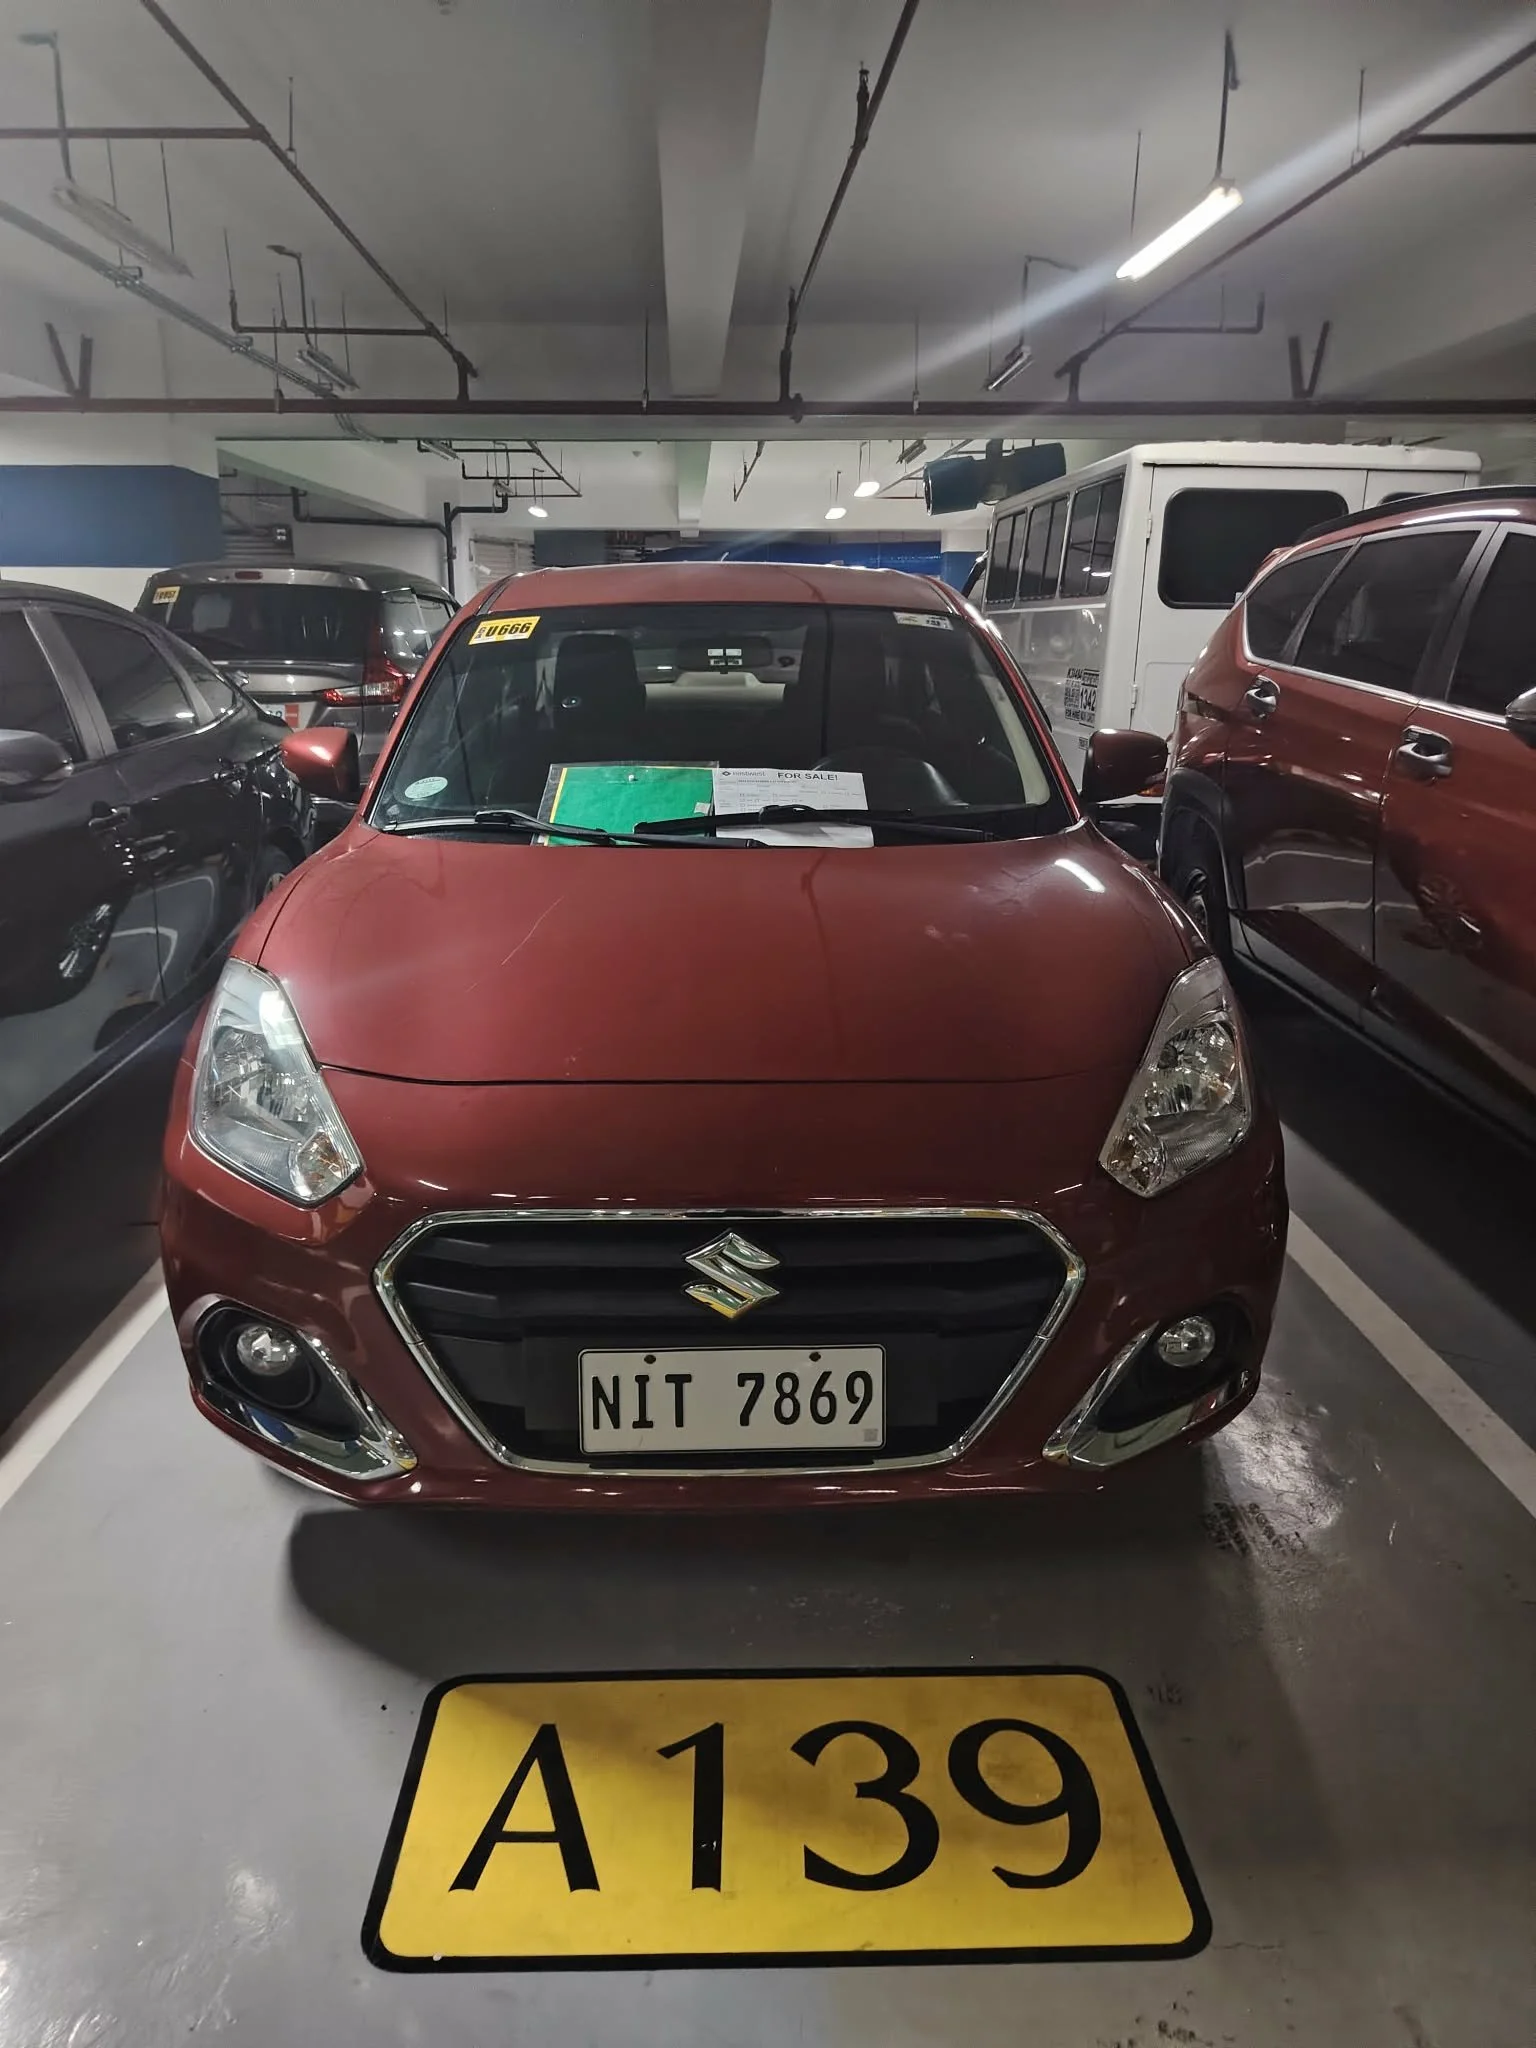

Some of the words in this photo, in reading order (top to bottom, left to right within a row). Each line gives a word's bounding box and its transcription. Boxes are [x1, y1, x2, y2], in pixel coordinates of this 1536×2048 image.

[485, 622, 533, 637] U666
[1080, 687, 1097, 712] 1342
[777, 772, 802, 780] FOR
[804, 773, 838, 781] SALE!
[591, 1373, 692, 1430] NIT
[736, 1370, 874, 1427] 7869
[447, 1717, 1102, 1892] A139
